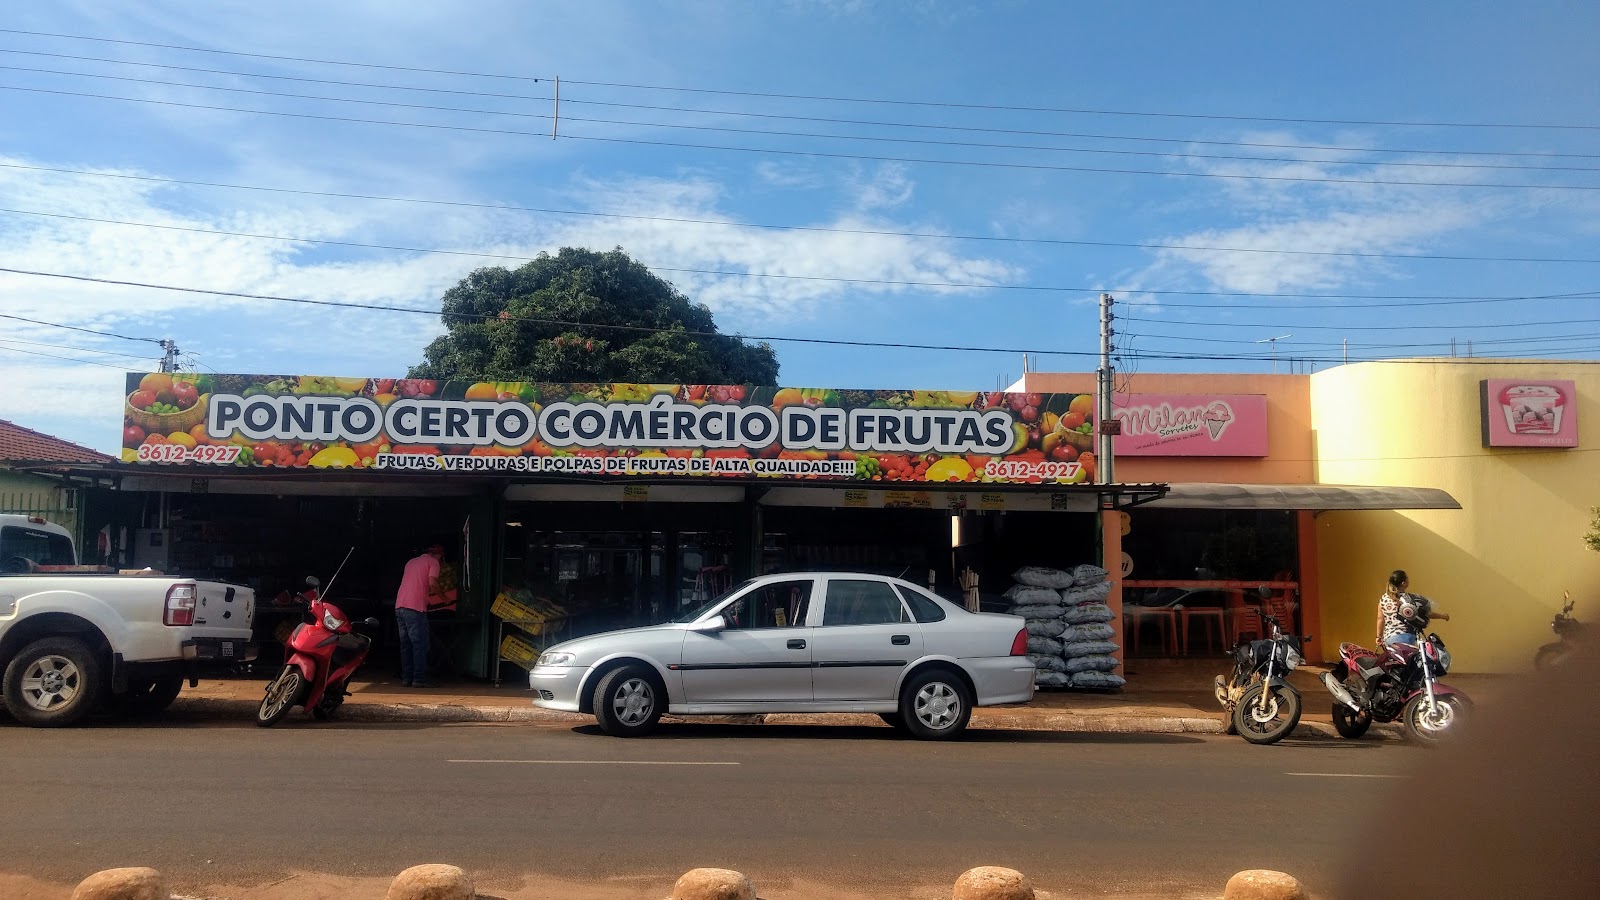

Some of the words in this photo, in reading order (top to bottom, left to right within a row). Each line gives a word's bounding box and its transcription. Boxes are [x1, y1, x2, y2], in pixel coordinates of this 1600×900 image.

[216, 401, 376, 435] PONTO
[392, 405, 529, 439] CERTO
[545, 402, 772, 442] COMÉRCIO
[788, 413, 839, 443] DE
[856, 415, 1007, 448] FRUTAS
[1159, 423, 1199, 438] Sorvetes
[139, 446, 240, 461] 3612-4927
[378, 455, 440, 470] FRUTAS,
[445, 457, 526, 470] VERDURAS
[531, 458, 539, 470] E
[544, 458, 602, 470] POLPAS
[607, 459, 626, 471] DE
[631, 459, 686, 471] FRUTAS
[691, 459, 710, 471] DE
[712, 460, 750, 472] ALTA
[754, 460, 855, 474] QUALIDADE!!!
[986, 463, 1078, 477] 3612-4927
